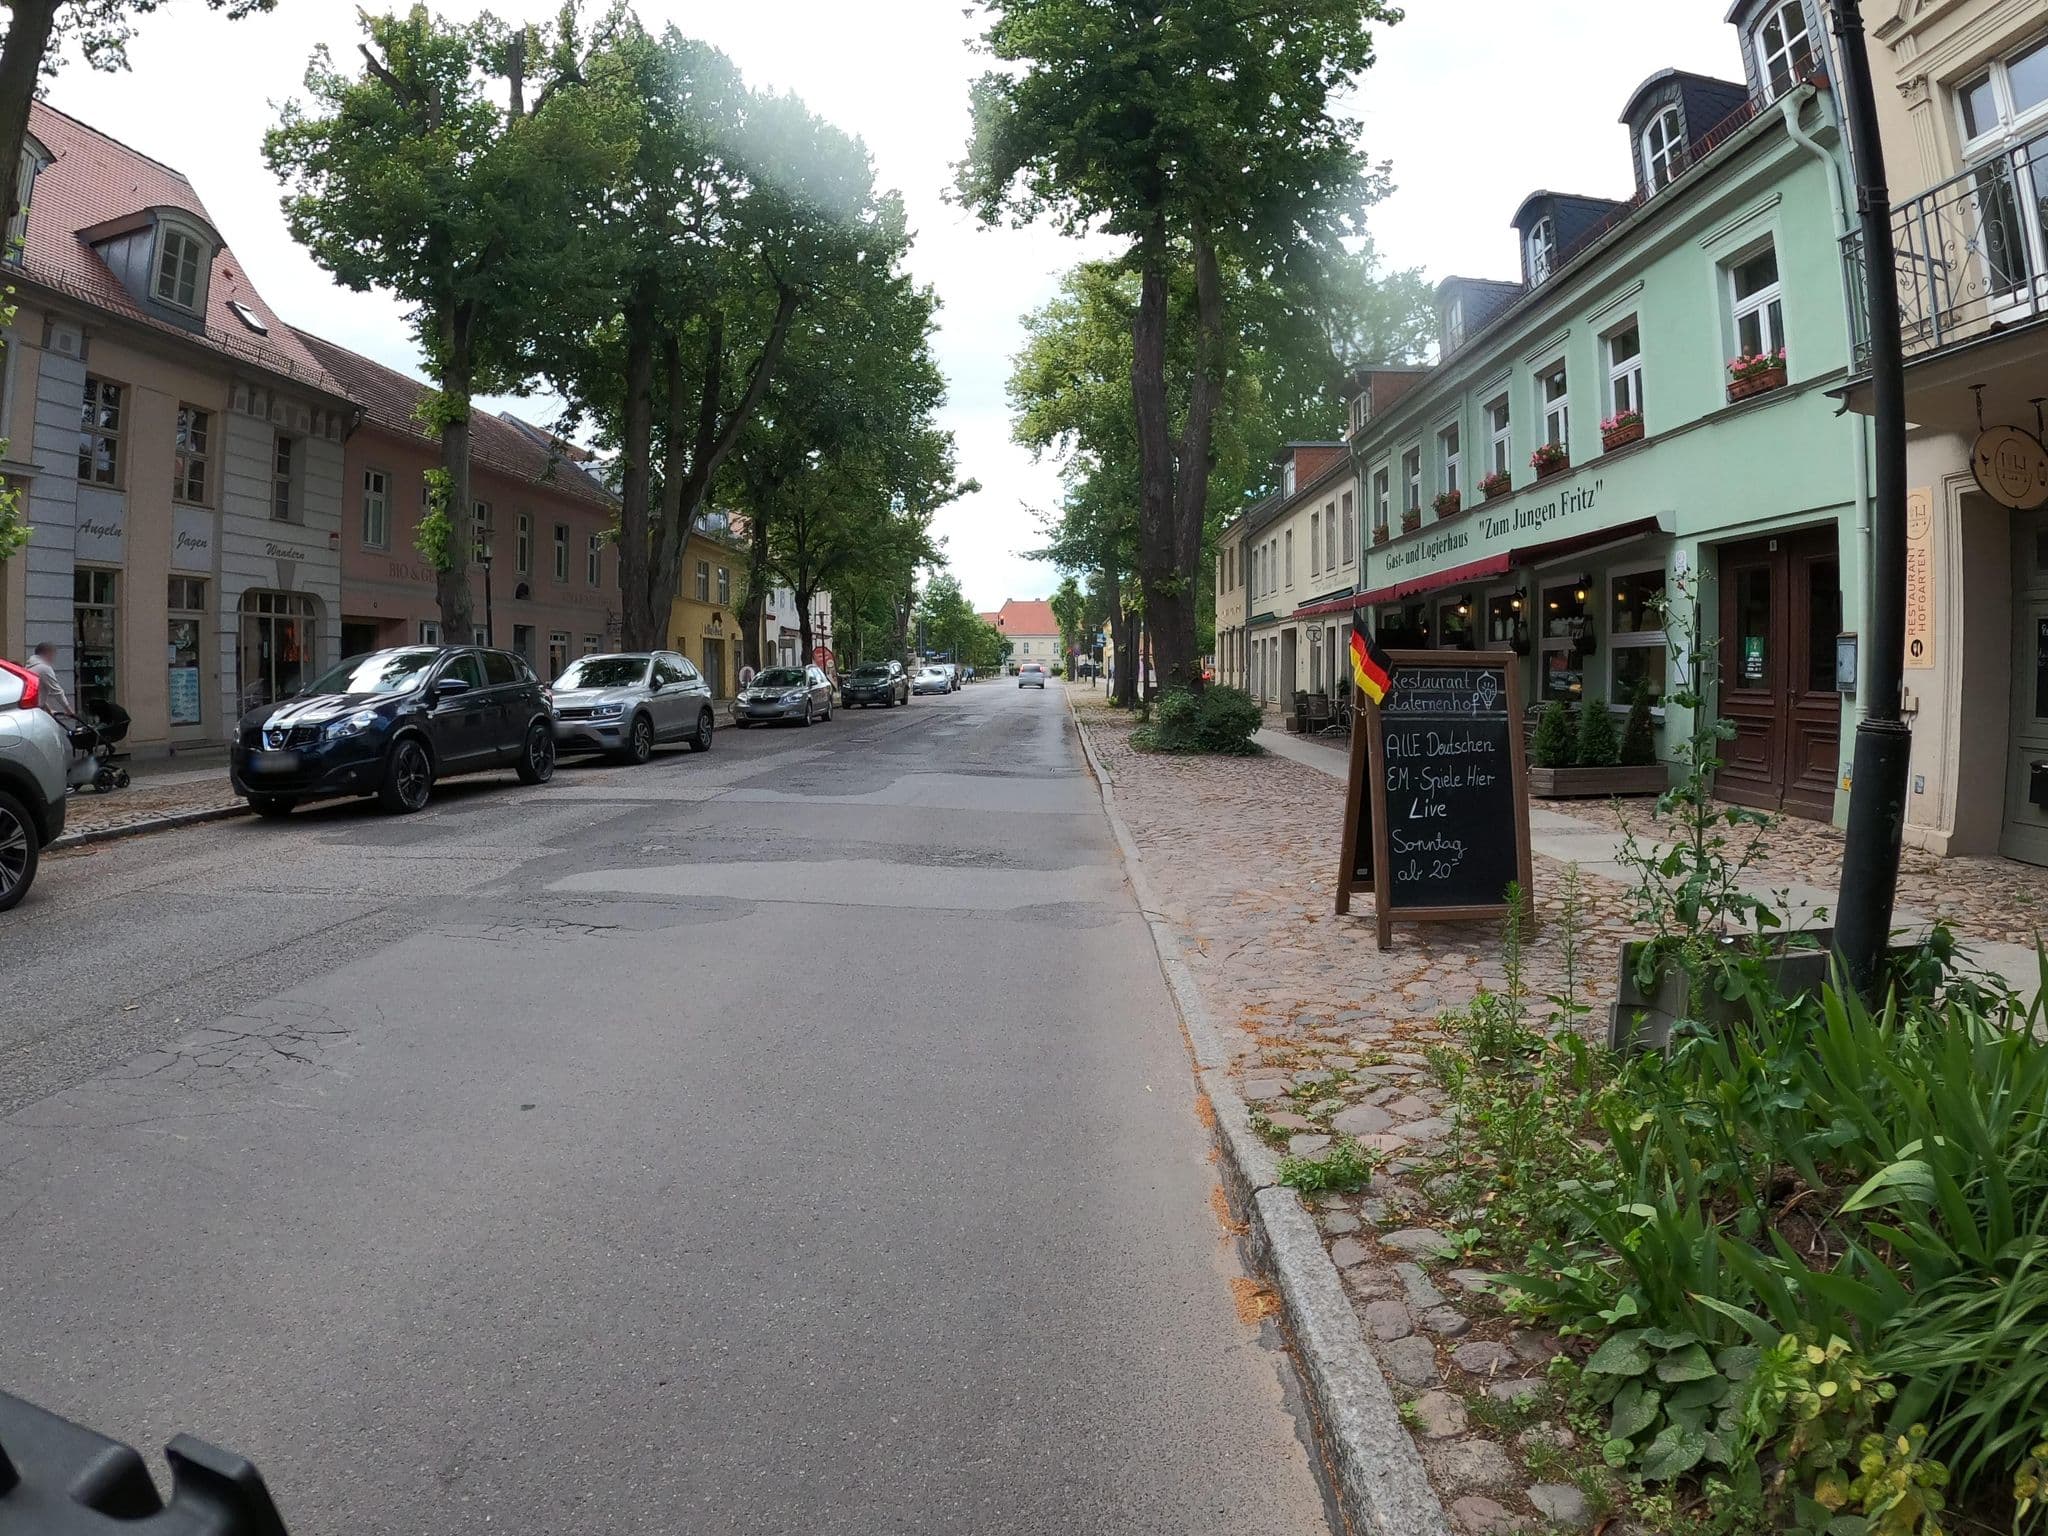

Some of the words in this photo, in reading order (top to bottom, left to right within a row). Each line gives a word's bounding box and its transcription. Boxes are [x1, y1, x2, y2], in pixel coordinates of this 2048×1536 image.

[77, 518, 122, 538] Angeln
[1386, 552, 1404, 571] Gast-
[1405, 548, 1419, 564] und
[1421, 531, 1468, 561] Logierhaus
[1479, 517, 1509, 539] "Zum
[1513, 503, 1556, 530] Jungen
[1561, 479, 1603, 516] Fritz"
[176, 531, 207, 550] Jagen
[265, 542, 305, 560] Wandern
[388, 561, 409, 577] BIO
[1917, 548, 1926, 632] HOFGARTEN
[1388, 690, 1481, 717] Laternenhof
[1426, 730, 1496, 757] Deutschen
[1466, 764, 1496, 787] Hier
[1408, 797, 1448, 819] Live
[1391, 829, 1468, 859] Sonntag
[1397, 859, 1423, 880] ab
